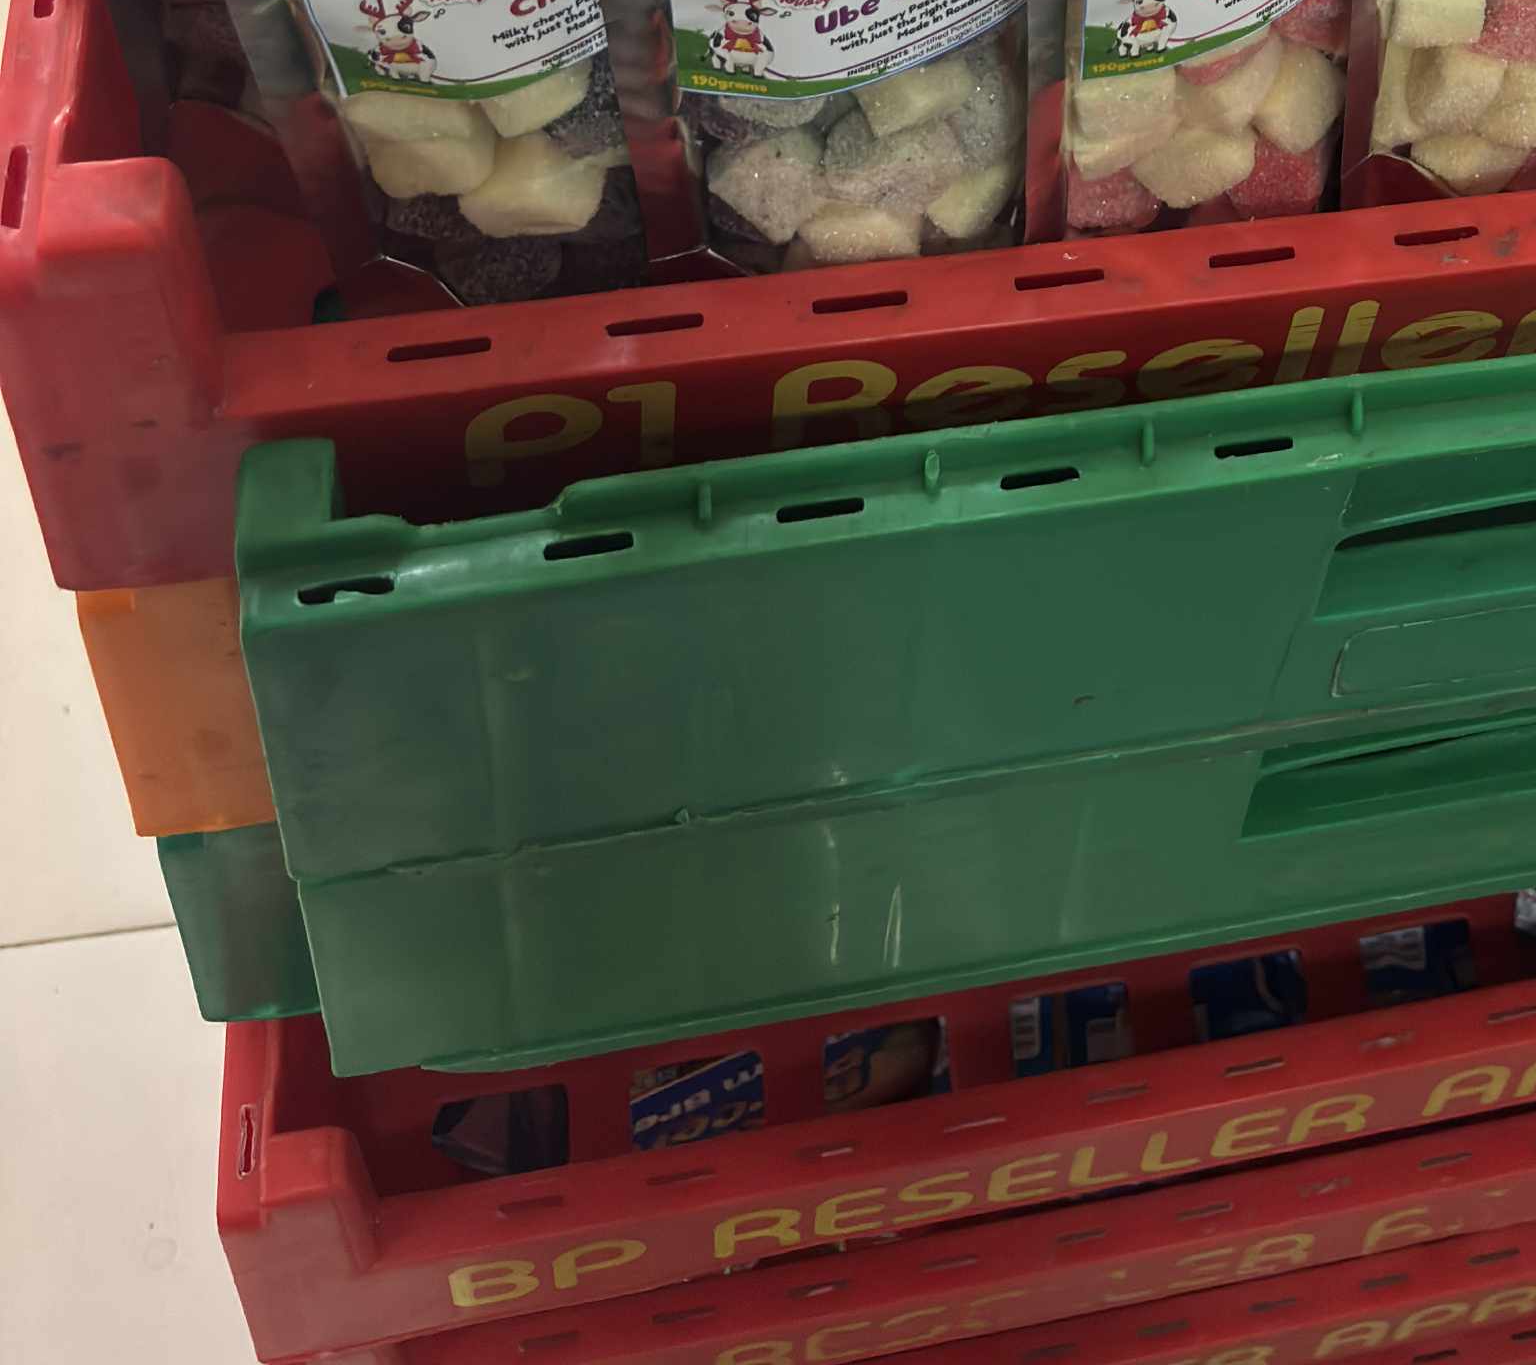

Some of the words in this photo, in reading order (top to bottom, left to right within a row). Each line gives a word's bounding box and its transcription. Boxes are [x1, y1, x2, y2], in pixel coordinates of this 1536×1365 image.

[492, 25, 529, 43] Milky
[532, 5, 573, 29] chewy
[504, 34, 535, 50] with
[536, 21, 563, 41] just
[564, 9, 586, 24] the
[565, 11, 601, 35] Made
[829, 25, 865, 46] Milky
[867, 12, 906, 32] chewy
[840, 37, 868, 52] with
[869, 25, 894, 43] just
[896, 17, 916, 30] the
[917, 1, 948, 22] right
[897, 22, 929, 40] Made
[932, 15, 943, 26] in
[690, 74, 768, 93] 190grams
[449, 1241, 648, 1308] BP
[714, 1094, 1373, 1257] RESELLER
